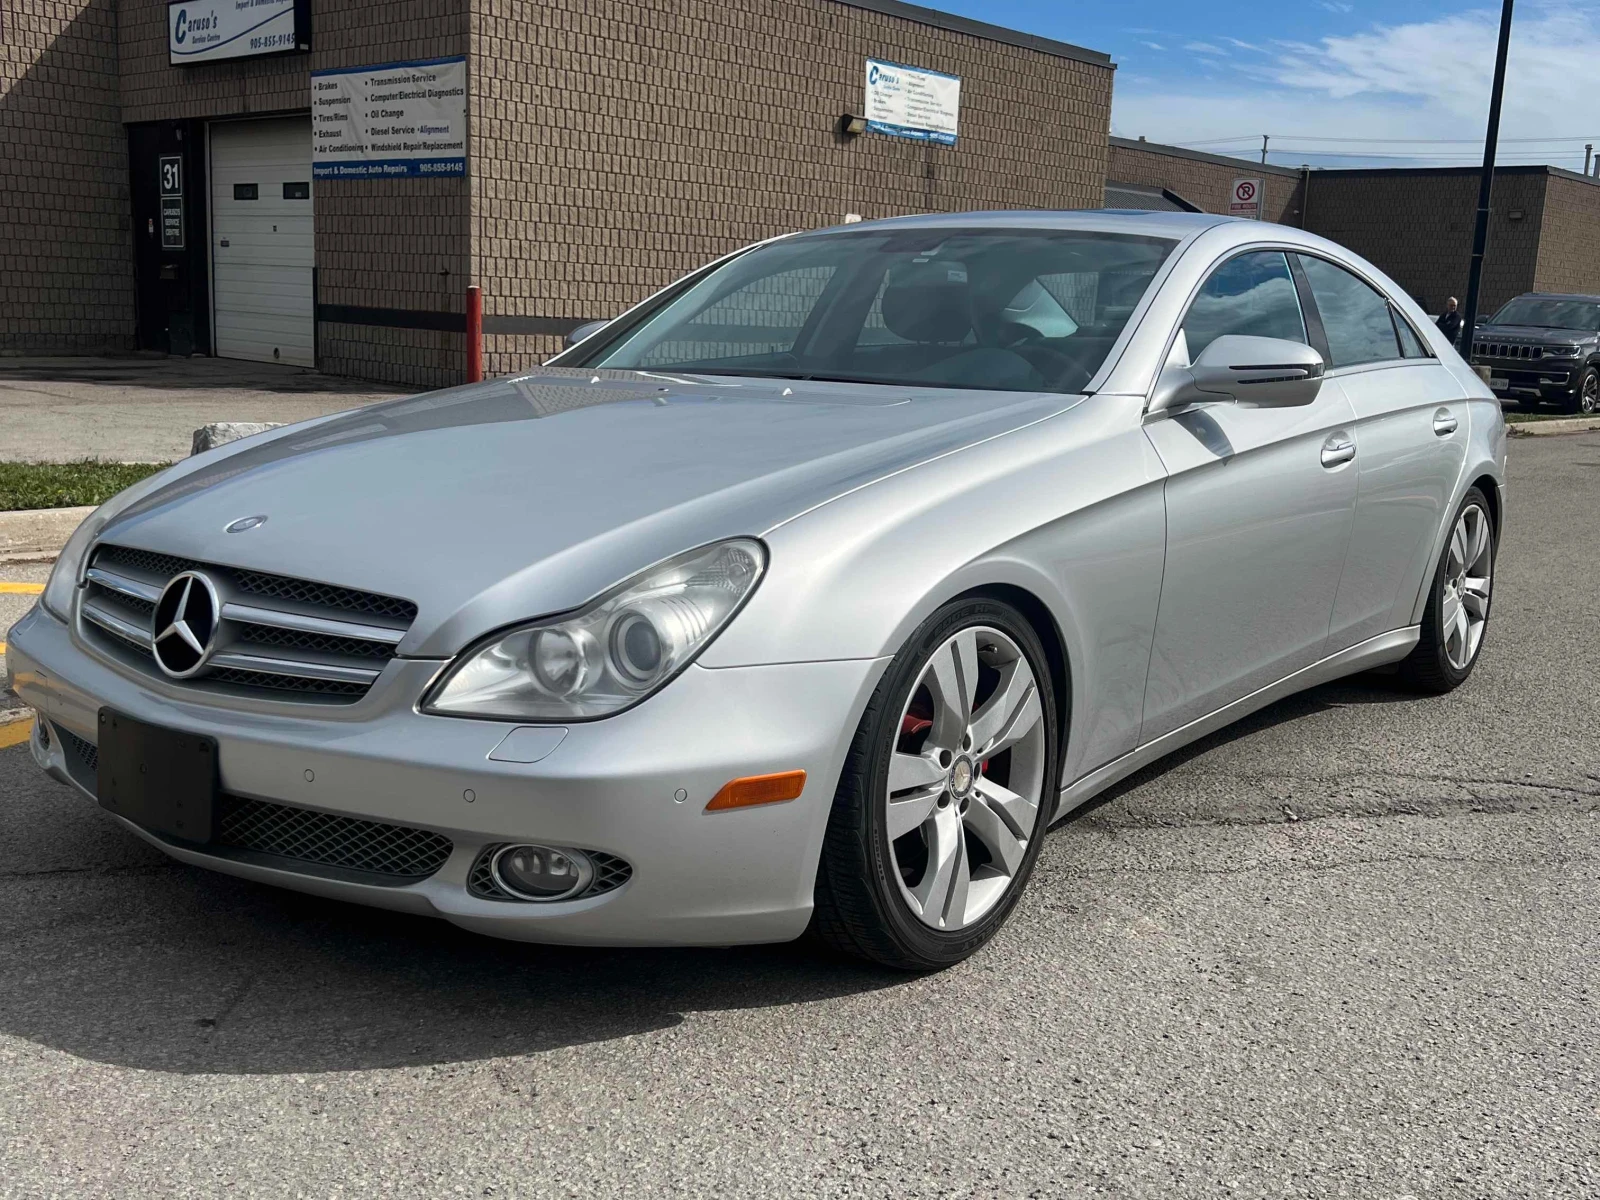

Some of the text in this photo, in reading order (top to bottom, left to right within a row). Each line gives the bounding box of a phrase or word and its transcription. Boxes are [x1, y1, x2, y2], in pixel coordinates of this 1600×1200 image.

[175, 9, 218, 44] Caruso's
[250, 33, 296, 49] 905-855-9145
[370, 74, 437, 86] Transmission Service
[318, 82, 338, 90] Brakes
[428, 87, 464, 99] Diagnostics
[318, 97, 351, 107] Suspension
[370, 109, 404, 119] Oil Change
[318, 129, 342, 138] Exhaust
[370, 125, 450, 136] Diesel Service Alignment
[318, 143, 364, 153] Air Conditioning
[371, 142, 401, 152] Windshield
[313, 162, 464, 176] Import & Domestic Auto Repairs 905-855-9145
[163, 164, 179, 189] 31
